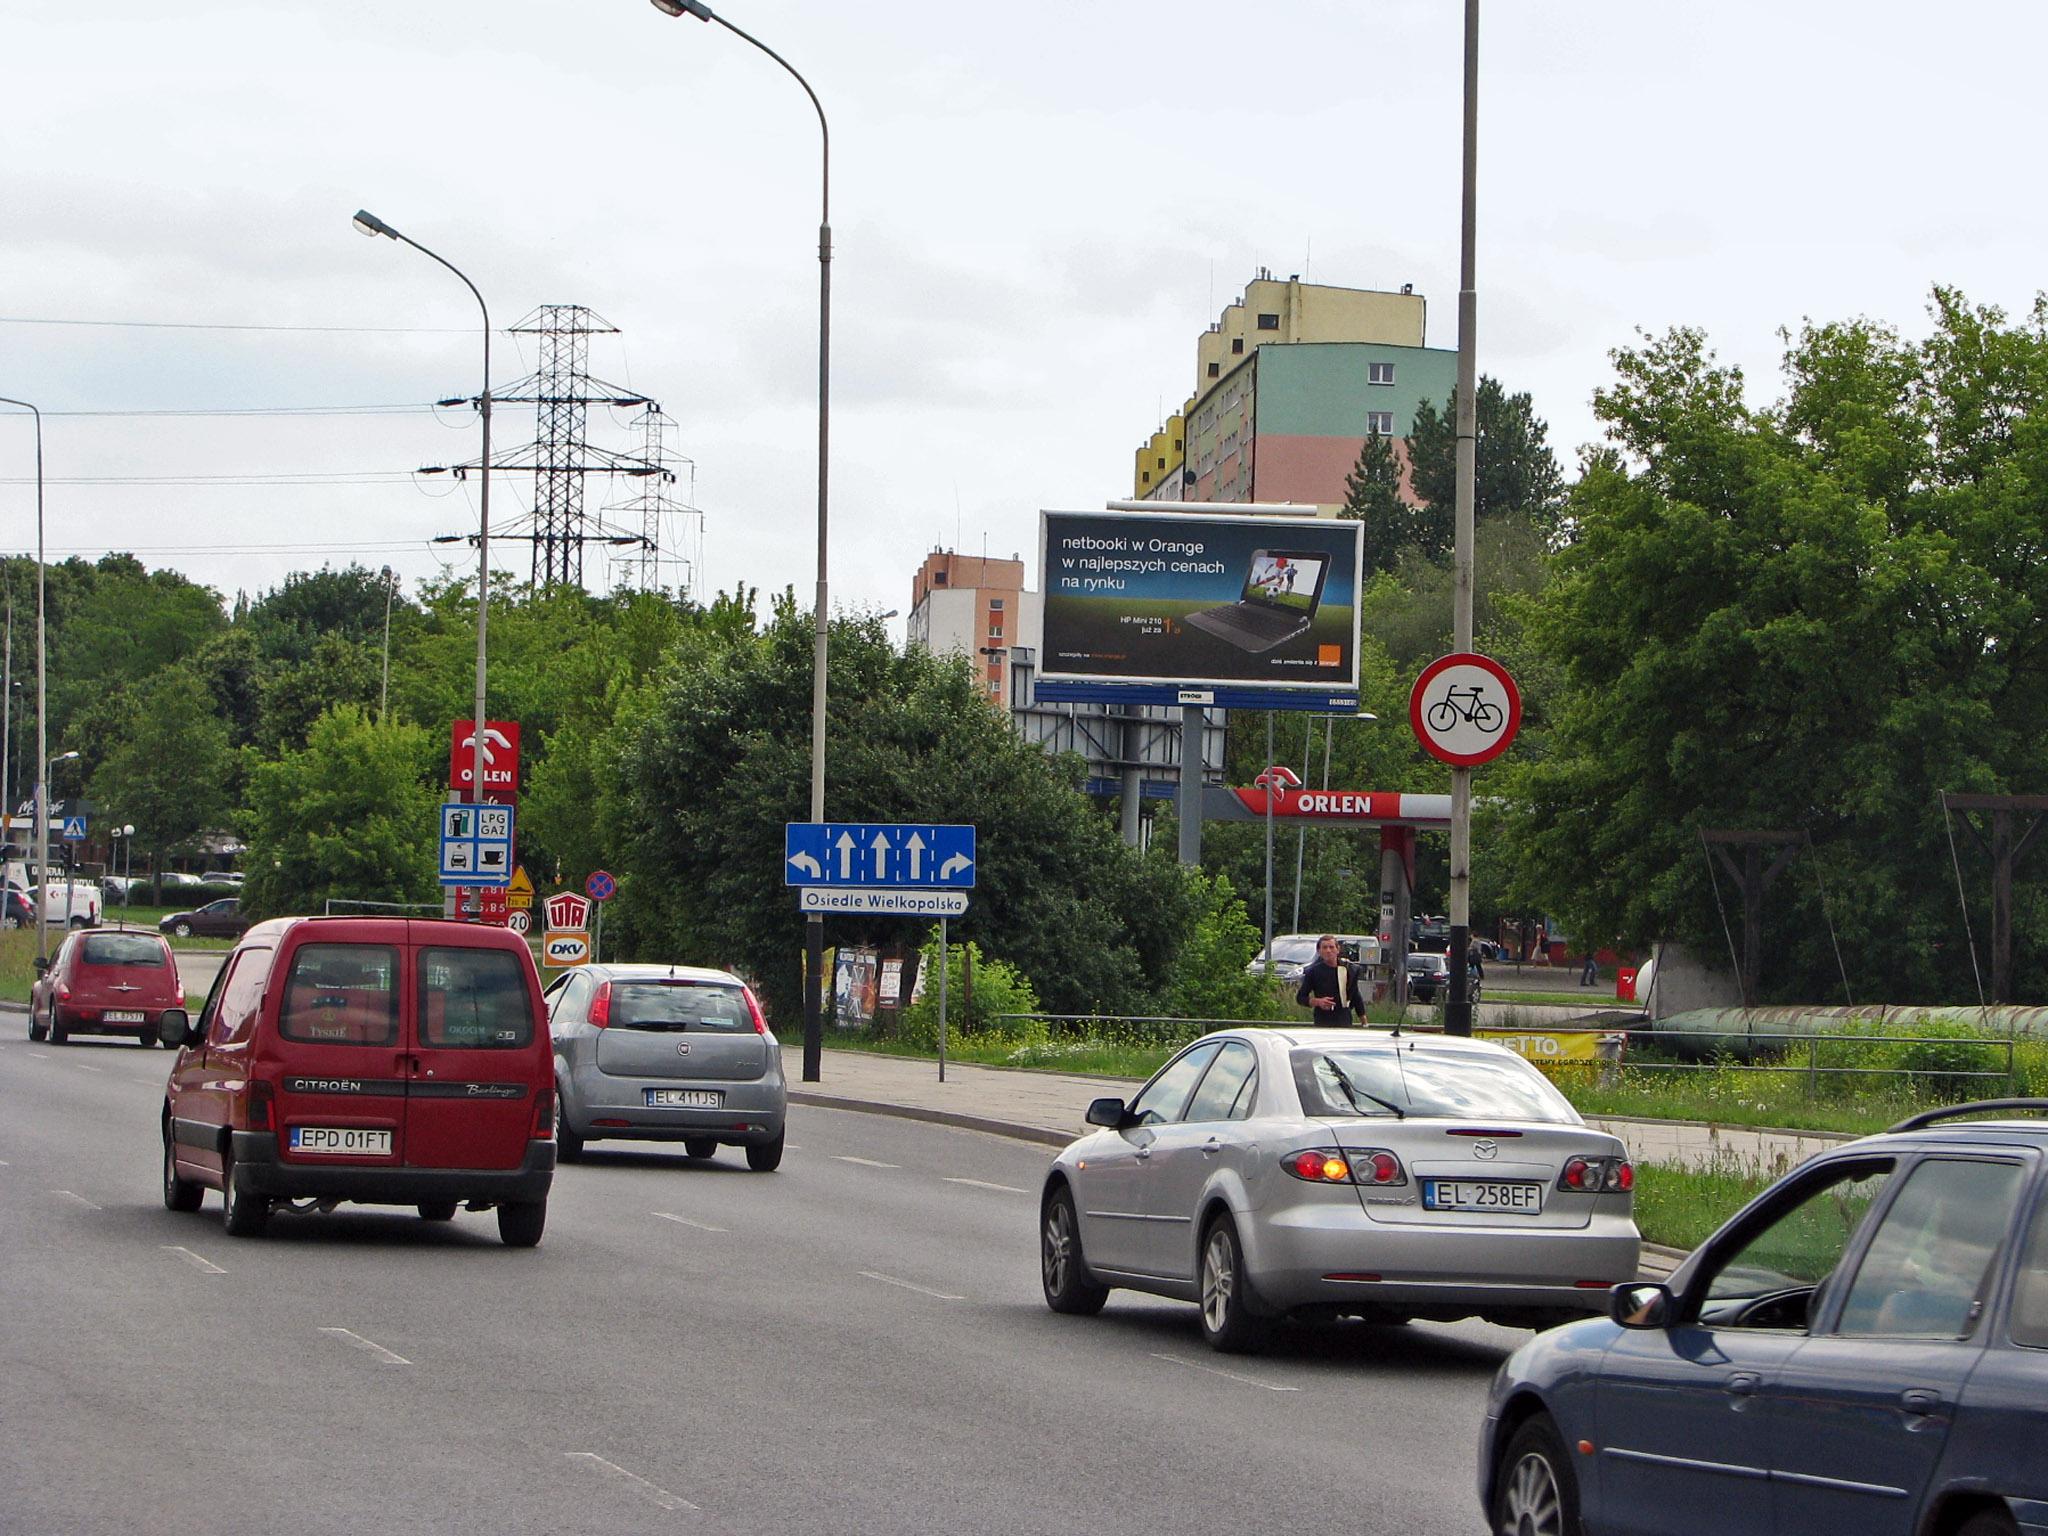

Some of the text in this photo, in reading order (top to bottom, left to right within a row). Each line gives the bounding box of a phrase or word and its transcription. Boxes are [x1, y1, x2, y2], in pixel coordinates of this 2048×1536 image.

[1062, 537, 1204, 556] netbooki w Orange
[1062, 557, 1225, 574] w najlepszych cenach
[1061, 577, 1125, 592] na rynku
[461, 769, 512, 783] OLEN
[1298, 794, 1371, 813] ORLEN
[481, 813, 506, 824] LPG
[481, 825, 505, 835] GAZ
[807, 892, 962, 912] Osiedle Wielkopolska
[549, 894, 587, 928] UTA
[510, 915, 527, 930] 20
[550, 944, 584, 955] DKV
[295, 1079, 361, 1091] CITROËN
[465, 1084, 517, 1097] Berlingo
[656, 1091, 717, 1105] EL 411JS
[302, 1129, 389, 1149] EPD 01FT
[1438, 1183, 1466, 1204] EL
[1475, 1184, 1536, 1207] 258EF
